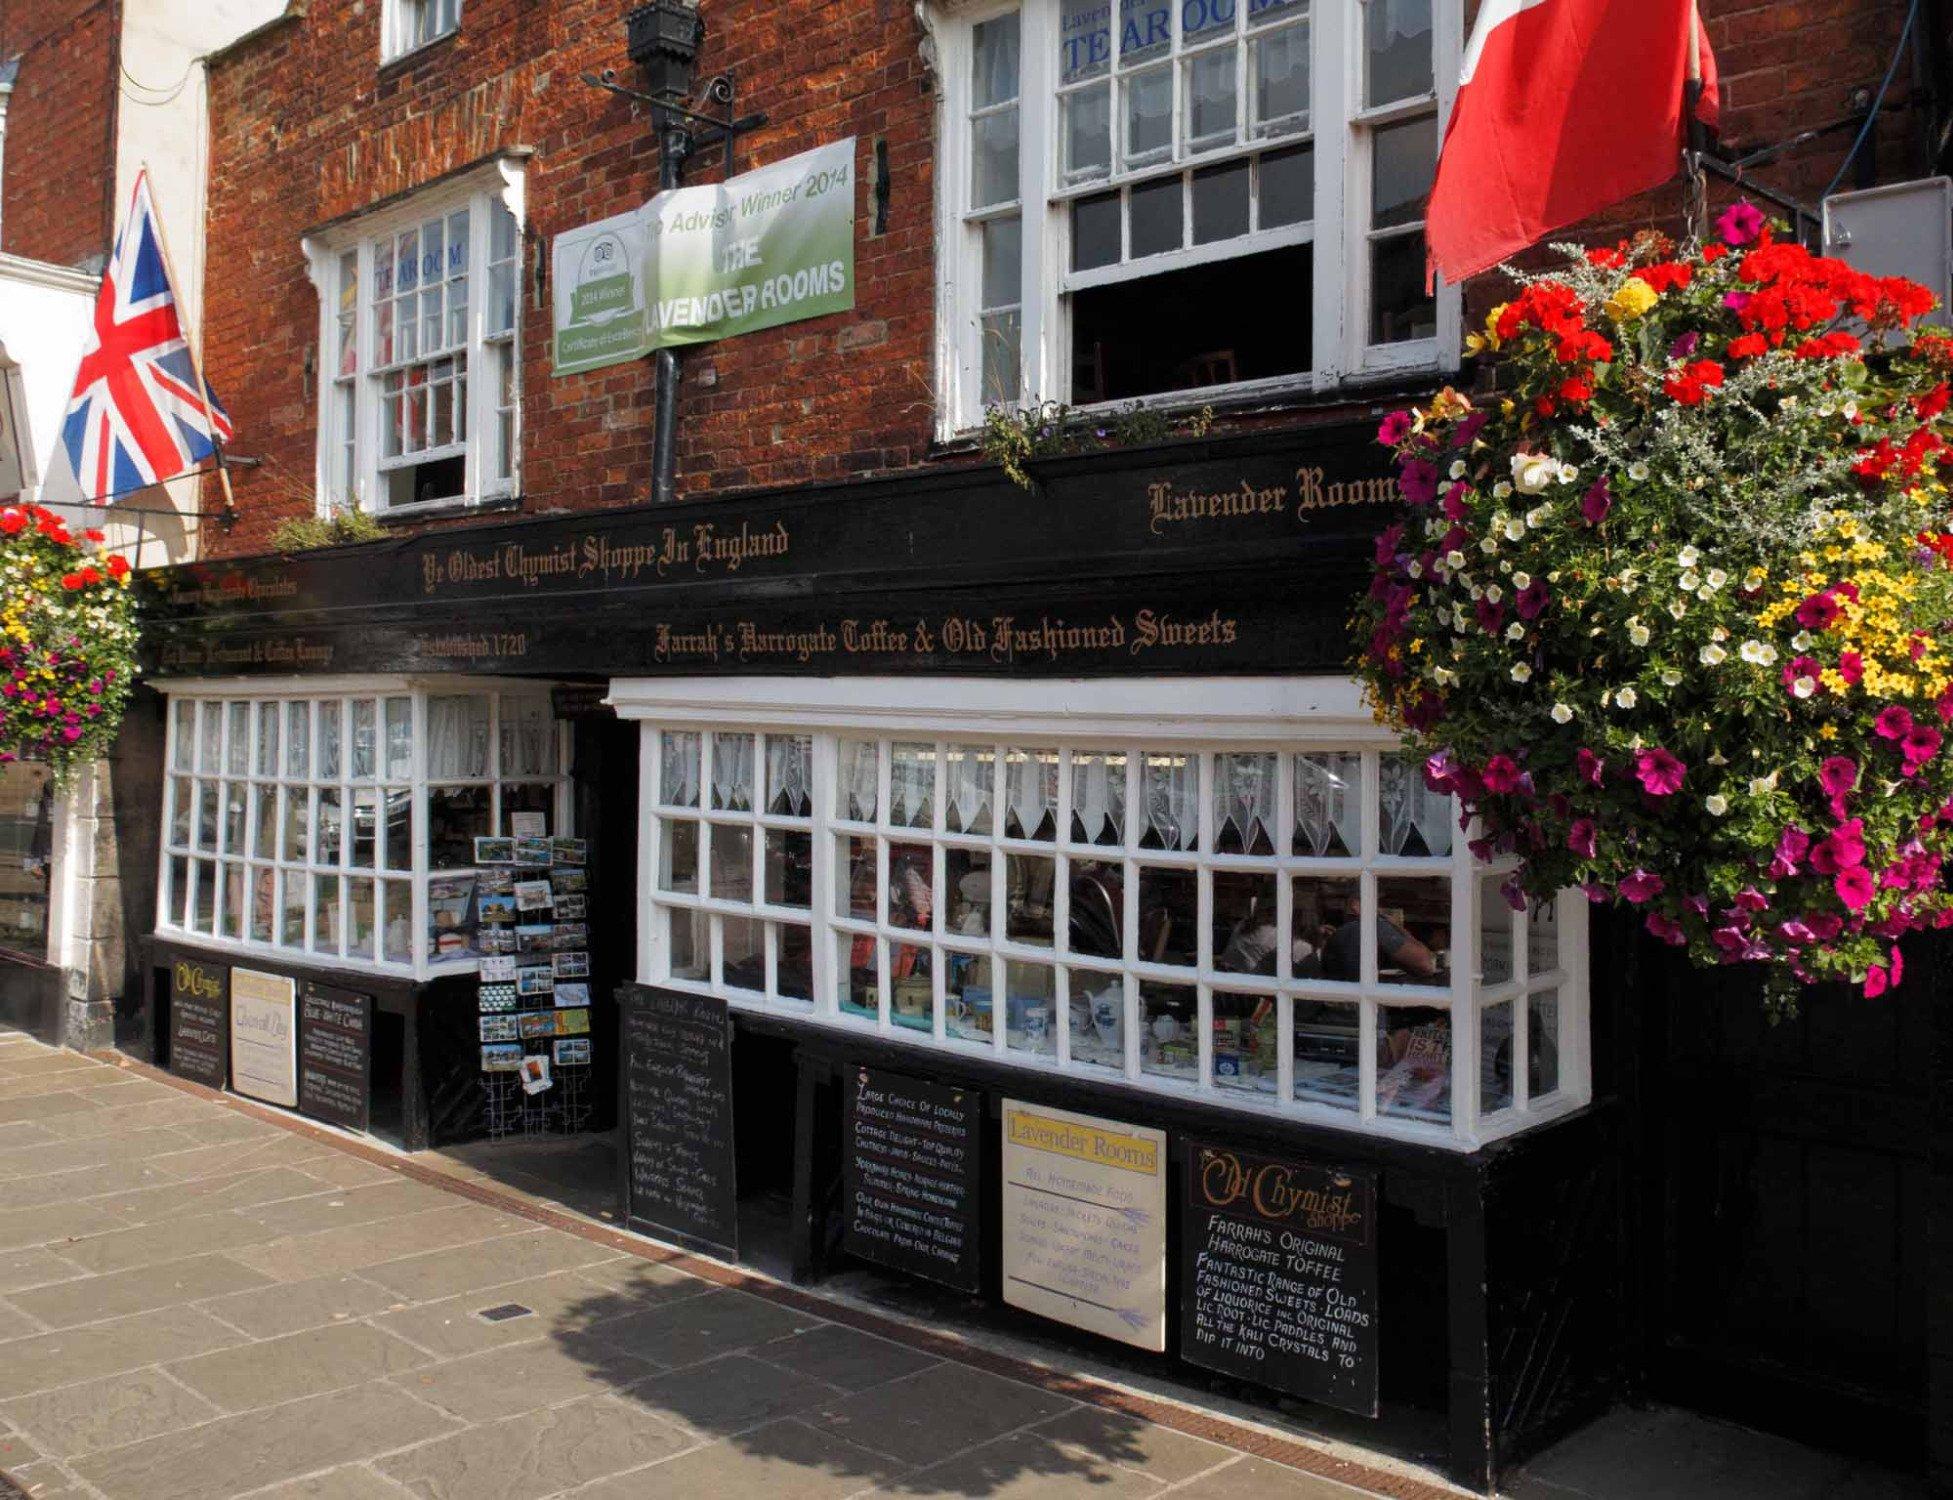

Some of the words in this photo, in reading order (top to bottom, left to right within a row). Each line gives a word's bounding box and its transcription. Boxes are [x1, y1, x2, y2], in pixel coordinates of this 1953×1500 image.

[741, 181, 802, 217] Winner
[805, 163, 848, 199] 2014
[760, 260, 846, 311] ROOMS
[1148, 480, 1286, 537] Lavender
[1296, 466, 1400, 523] Room
[422, 554, 444, 594] Ye
[447, 549, 500, 581] Oldest
[504, 542, 578, 586] Chymist
[577, 535, 656, 579] Shoppe
[656, 527, 690, 577] In
[693, 521, 791, 573] England
[492, 632, 526, 657] 1720
[654, 622, 735, 664] Farrah's
[736, 618, 838, 663] Harrogate
[842, 618, 908, 655] Toffee
[913, 617, 936, 653] &
[942, 616, 986, 653] Old
[990, 614, 1126, 664] Fashioned
[1131, 607, 1238, 655] Sweets
[1010, 1115, 1087, 1152] Lavender
[1093, 1133, 1156, 1170] Rooms
[1252, 1163, 1352, 1218] Chymist
[1207, 1214, 1272, 1244] FARRAH'S
[1279, 1230, 1346, 1263] ORIGINAL
[1207, 1234, 1280, 1266] HARROGATE
[1286, 1253, 1342, 1282] TOFFEE
[1197, 1251, 1265, 1285] FANTASTIC
[1267, 1271, 1305, 1296] RANGE
[1197, 1269, 1263, 1298] FASHIONED
[1265, 1287, 1318, 1314] SWEETS
[1325, 1304, 1370, 1328] LOADS
[1213, 1288, 1273, 1316] LIQUORICE
[1296, 1311, 1356, 1339] ORIGINAL
[1273, 1319, 1326, 1347] PADDLES
[1331, 1336, 1357, 1354] AND
[1235, 1342, 1266, 1362] INTO
[1267, 1332, 1330, 1363] CRYSTALS
